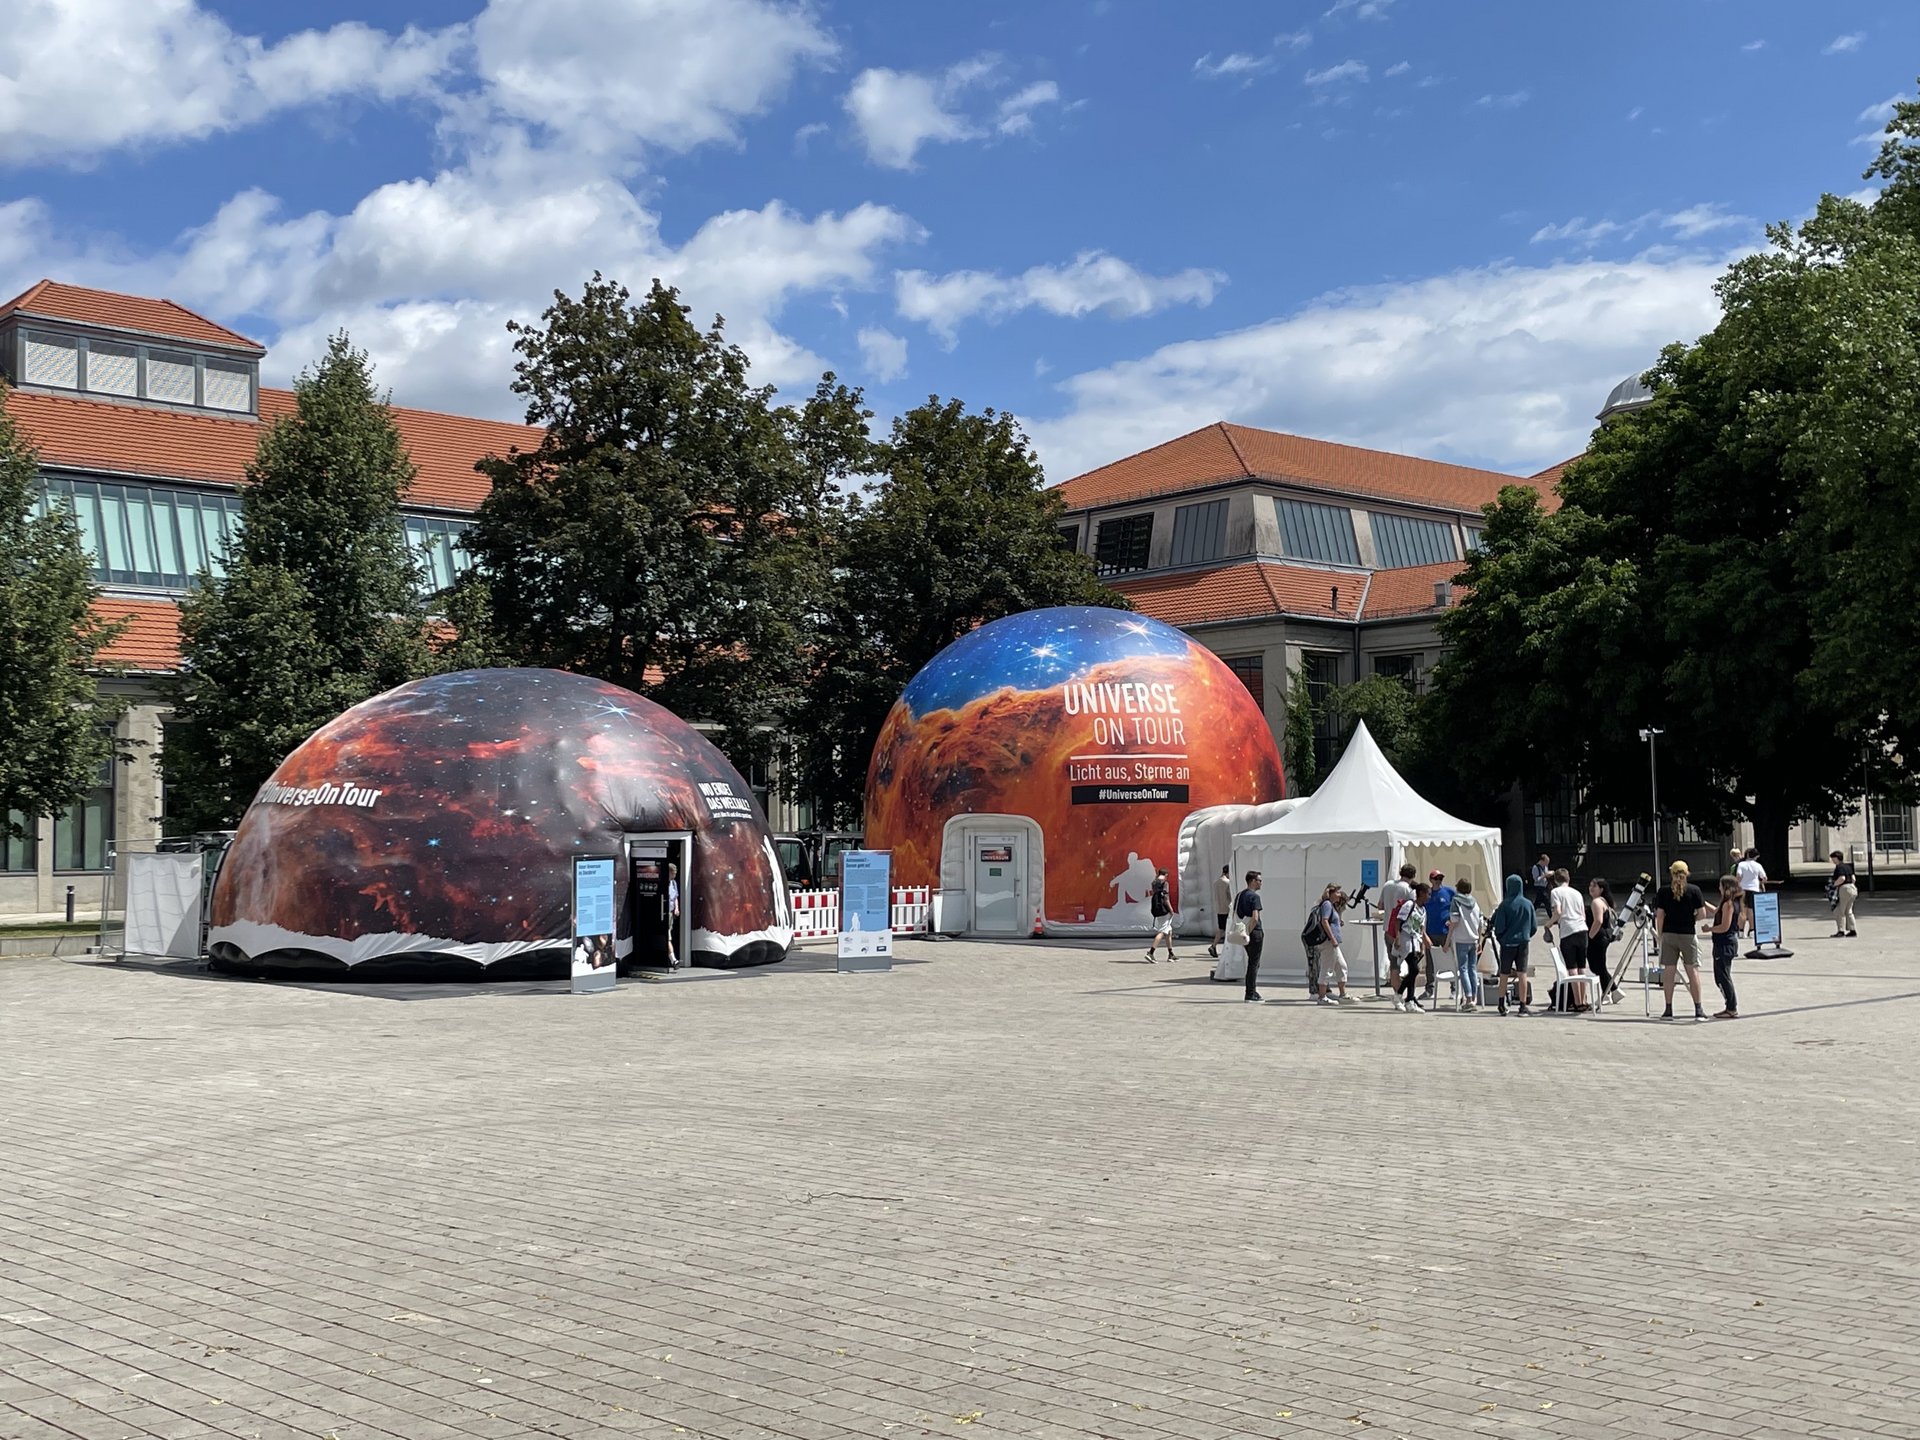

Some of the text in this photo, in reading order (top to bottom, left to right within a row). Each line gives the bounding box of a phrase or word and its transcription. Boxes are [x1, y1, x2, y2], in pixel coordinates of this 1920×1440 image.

[1063, 683, 1181, 715] UNIVERSE
[1094, 717, 1186, 745] ON TOUR
[1070, 762, 1190, 781] Licht aus, Sterne an
[1099, 788, 1169, 801] #UniverseOnTour
